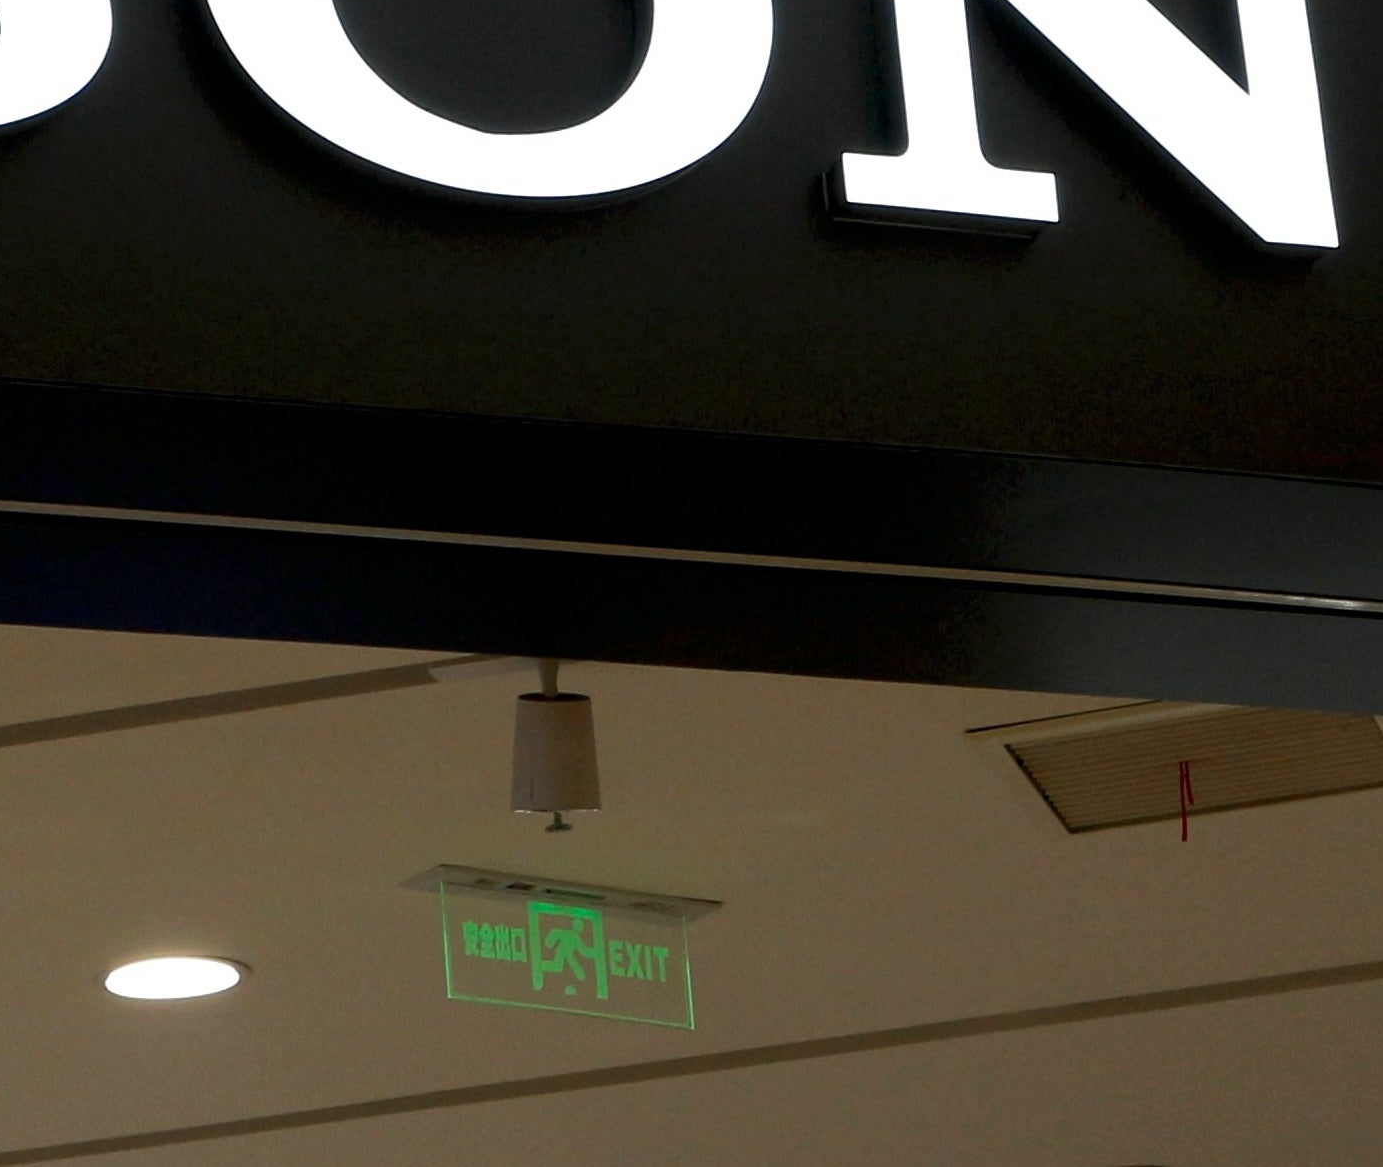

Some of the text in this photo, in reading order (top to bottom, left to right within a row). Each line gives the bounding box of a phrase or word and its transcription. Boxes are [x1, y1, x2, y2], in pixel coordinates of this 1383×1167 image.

[464, 921, 527, 962] 安全出口
[609, 941, 669, 981] EXIT
